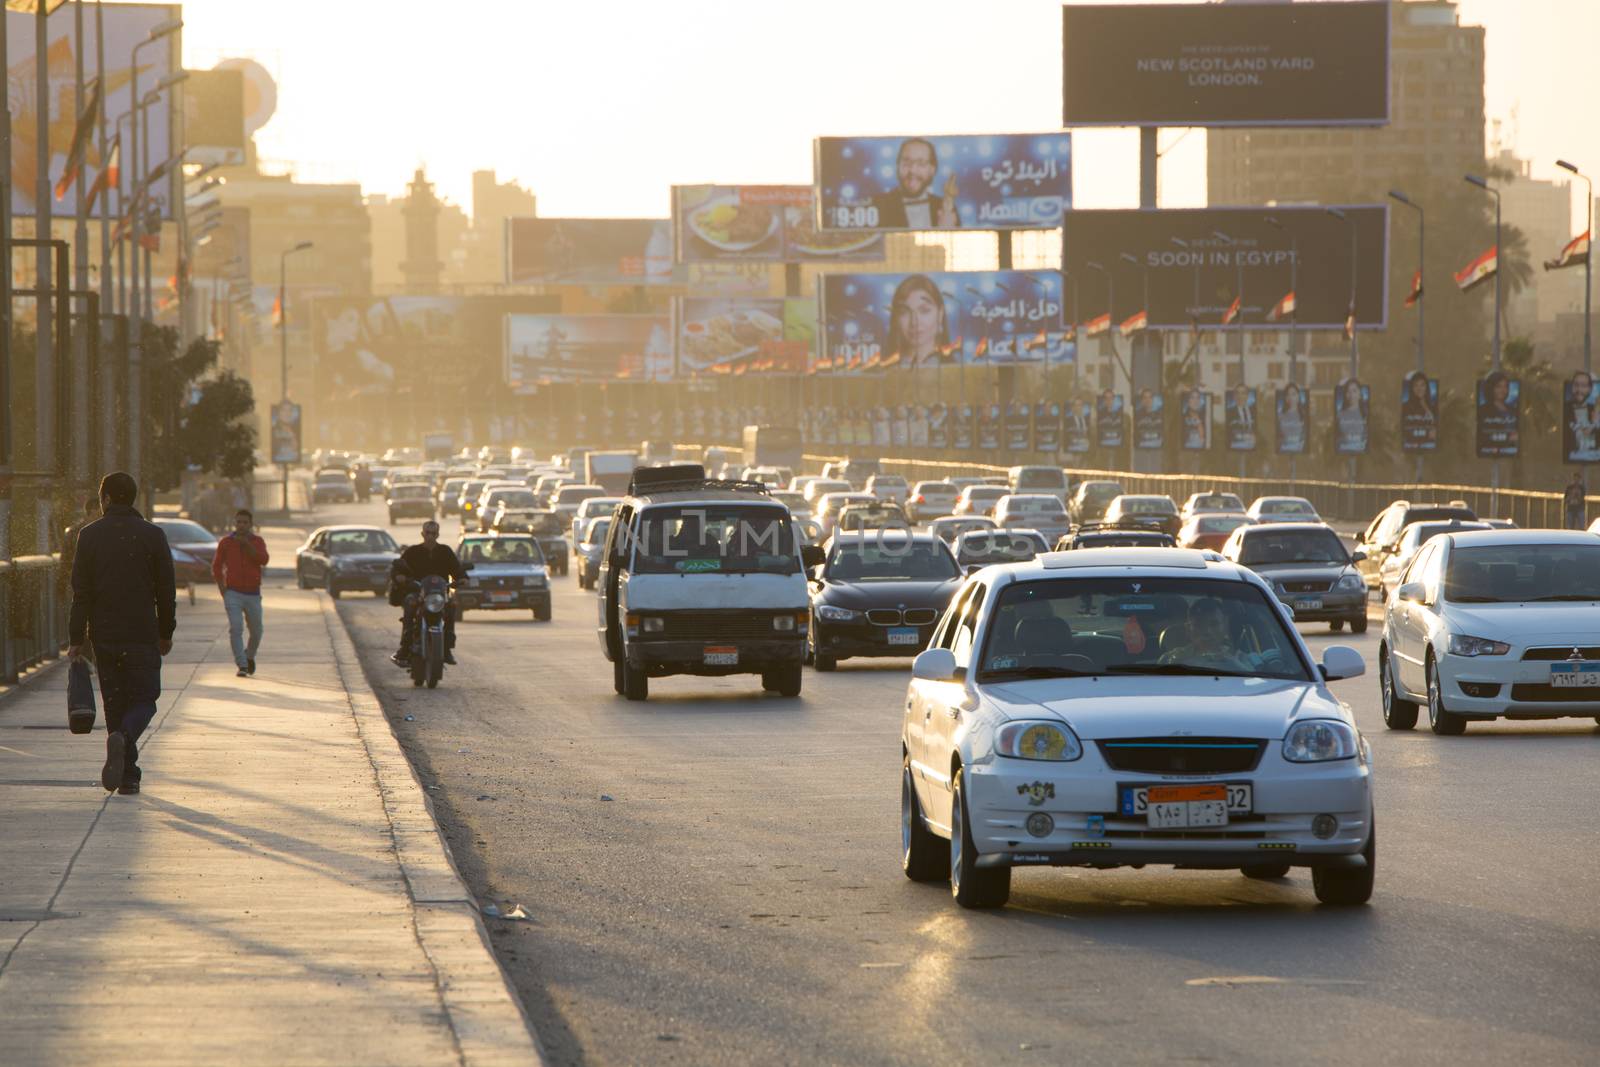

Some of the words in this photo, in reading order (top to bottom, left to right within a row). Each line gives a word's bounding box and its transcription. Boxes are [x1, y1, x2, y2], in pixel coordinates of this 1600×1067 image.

[1136, 57, 1174, 73] NEW
[1178, 57, 1267, 72] SCOTLAND
[1271, 56, 1315, 71] YARD
[1188, 72, 1264, 87] LONDON.
[837, 206, 880, 228] 9:00
[1147, 251, 1204, 267] SOON
[1209, 251, 1230, 266] IN
